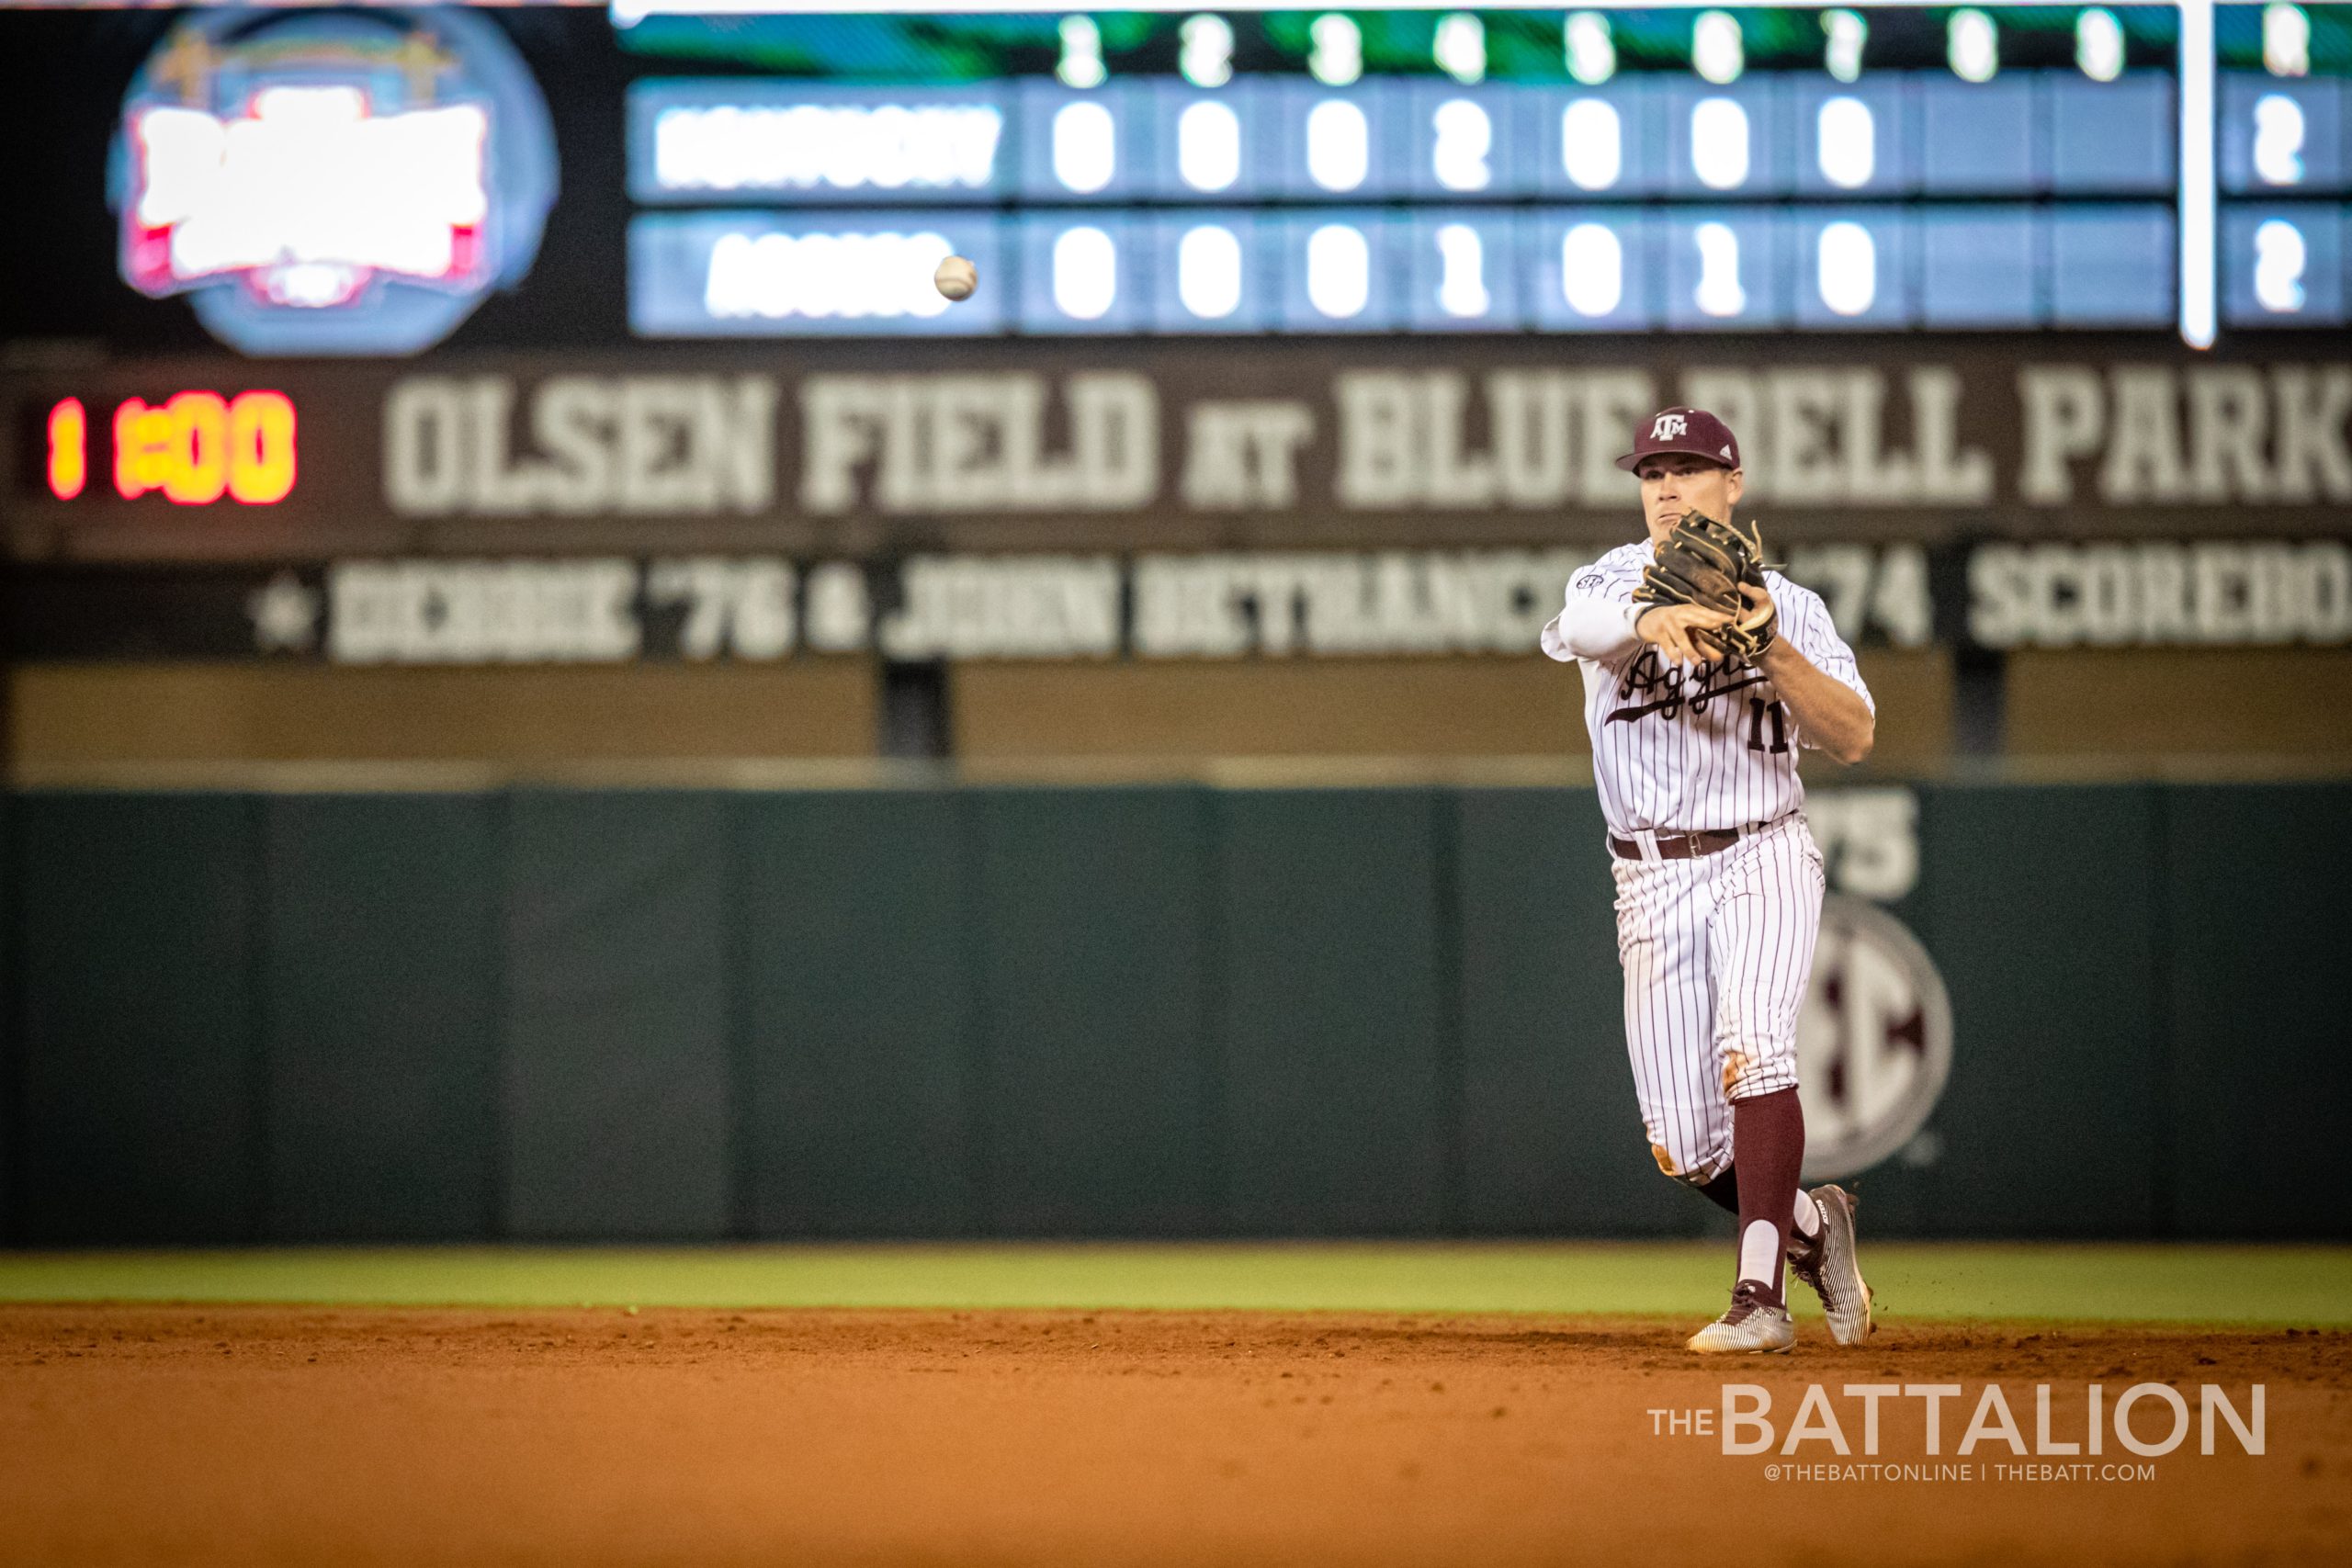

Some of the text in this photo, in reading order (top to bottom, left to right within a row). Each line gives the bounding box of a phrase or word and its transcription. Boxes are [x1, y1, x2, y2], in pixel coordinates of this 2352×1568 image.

[1053, 101, 1114, 193] 0
[1179, 101, 1239, 192] 0
[1307, 99, 1368, 192] 0
[1433, 99, 1491, 191] 2
[1562, 98, 1621, 191] 0
[1691, 97, 1748, 190] 0
[1818, 96, 1874, 188] 0
[2255, 95, 2304, 184] 2
[1053, 226, 1115, 318] 0
[1179, 226, 1240, 318] 0
[1307, 224, 1369, 318] 0
[1436, 224, 1490, 317] 1
[1563, 223, 1622, 317] 0
[1695, 222, 1746, 316] 1
[1818, 221, 1875, 315] 0
[2255, 220, 2304, 311] 2
[386, 378, 772, 512] OLSEN
[802, 375, 1158, 511] FIELD
[1185, 403, 1314, 508] AT
[1337, 371, 1657, 508] BLUE
[2023, 369, 2352, 504] PARK
[1747, 697, 1788, 753] 11
